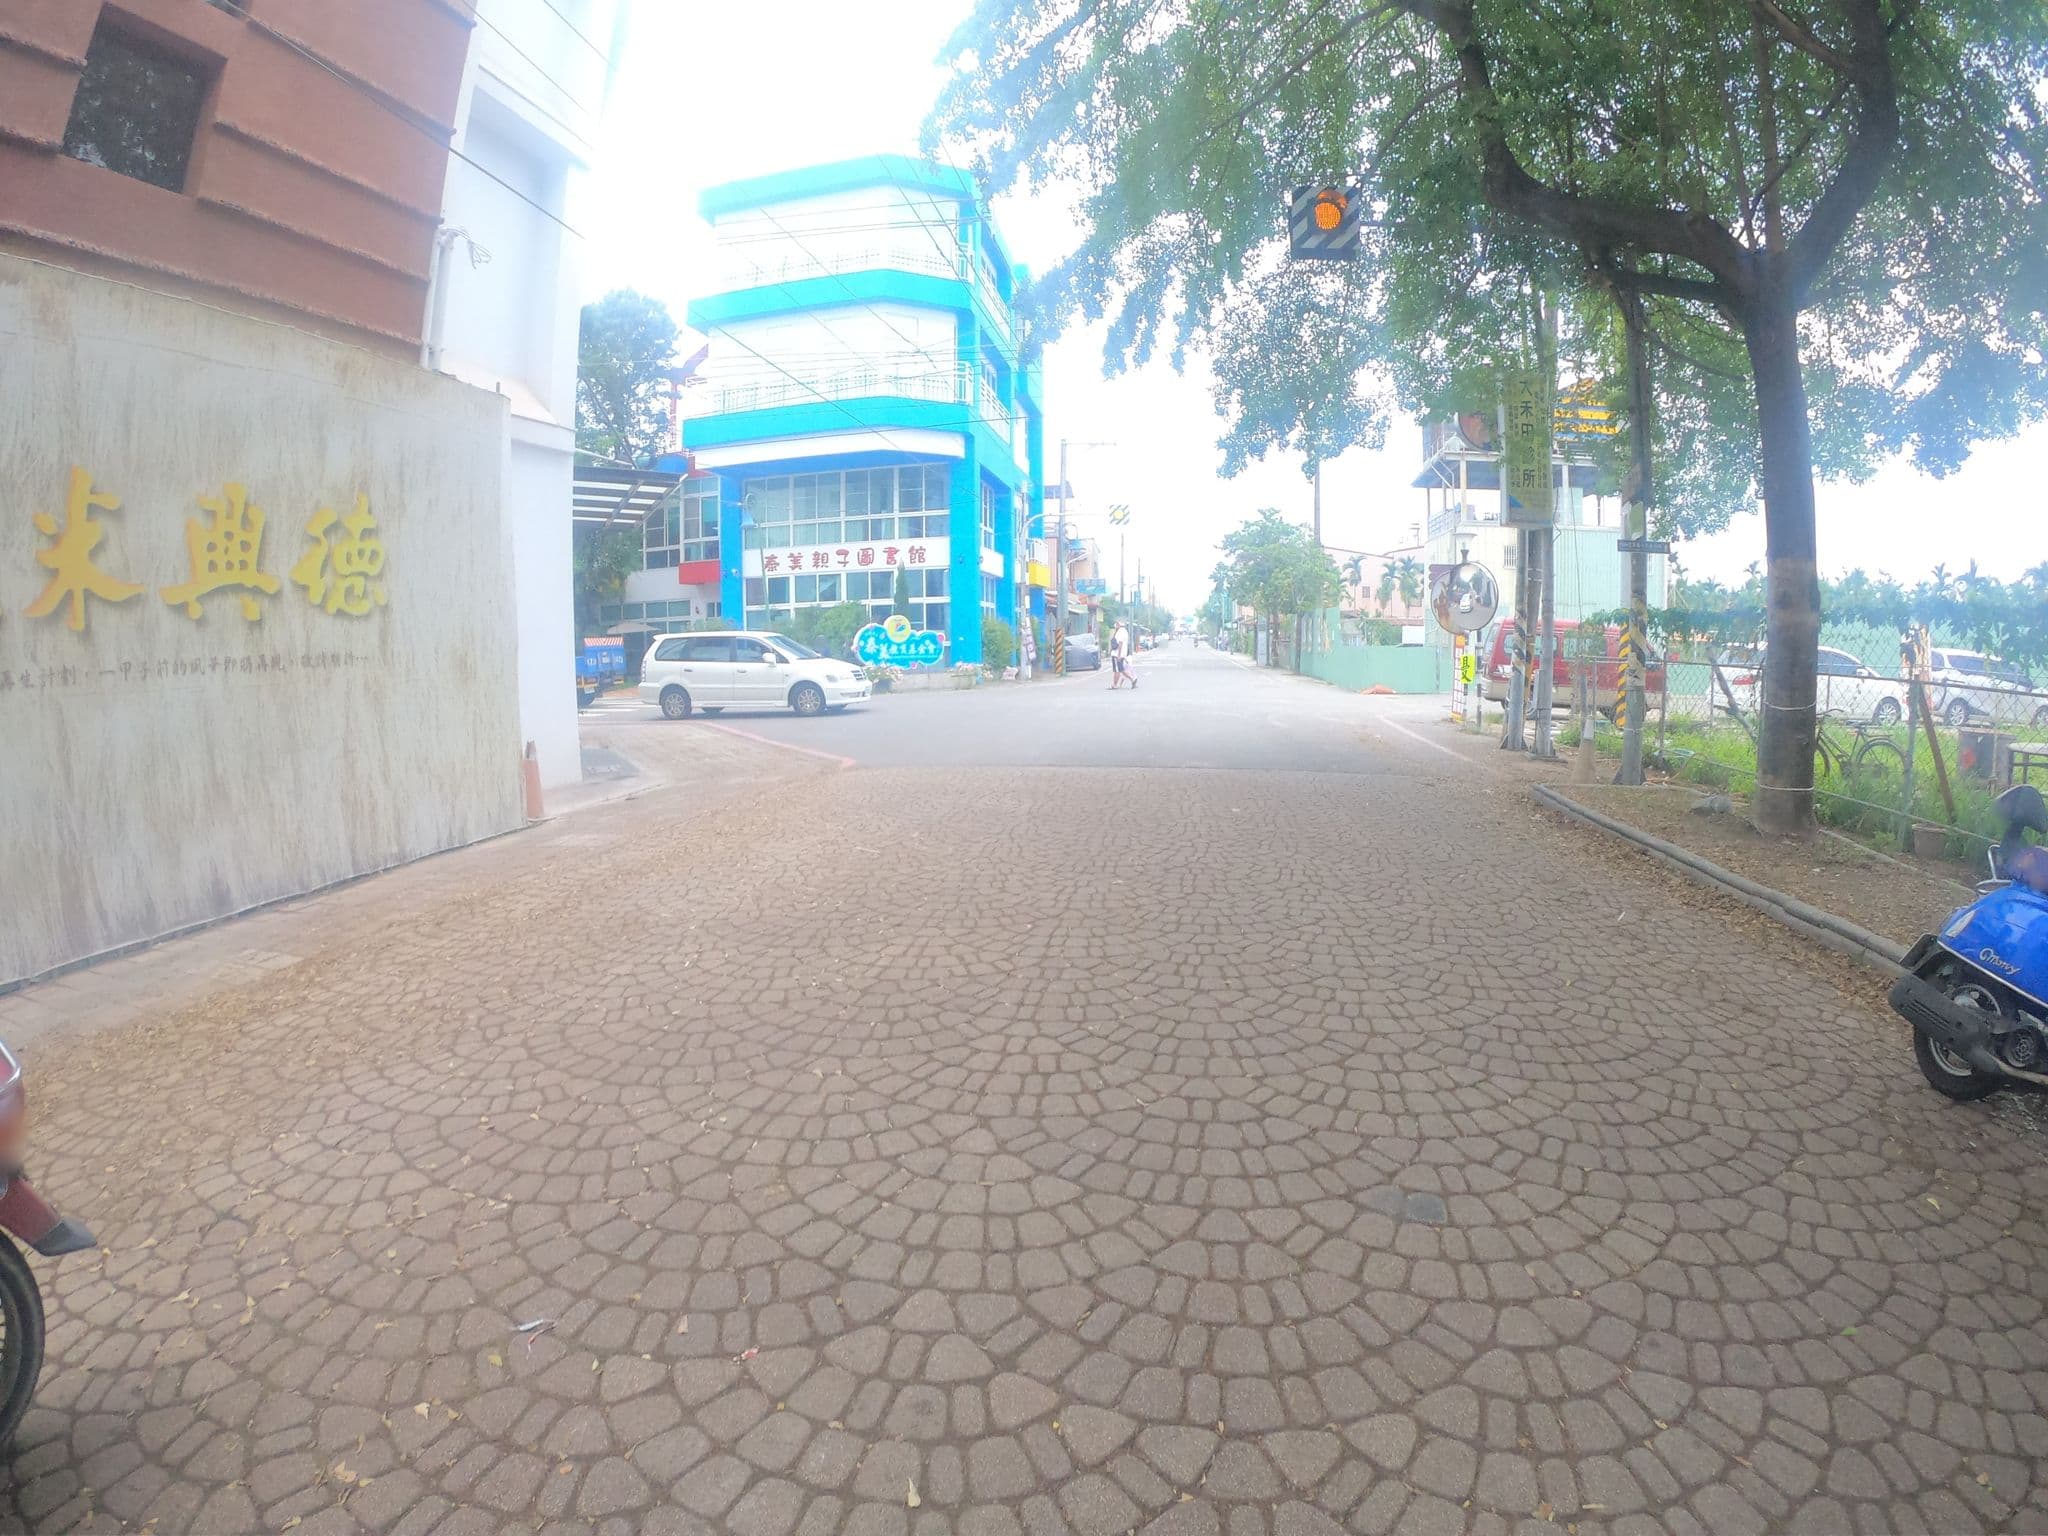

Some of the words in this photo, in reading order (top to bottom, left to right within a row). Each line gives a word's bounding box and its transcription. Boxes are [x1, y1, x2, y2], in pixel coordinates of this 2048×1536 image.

[764, 544, 927, 572] 泰美親子圖書館
